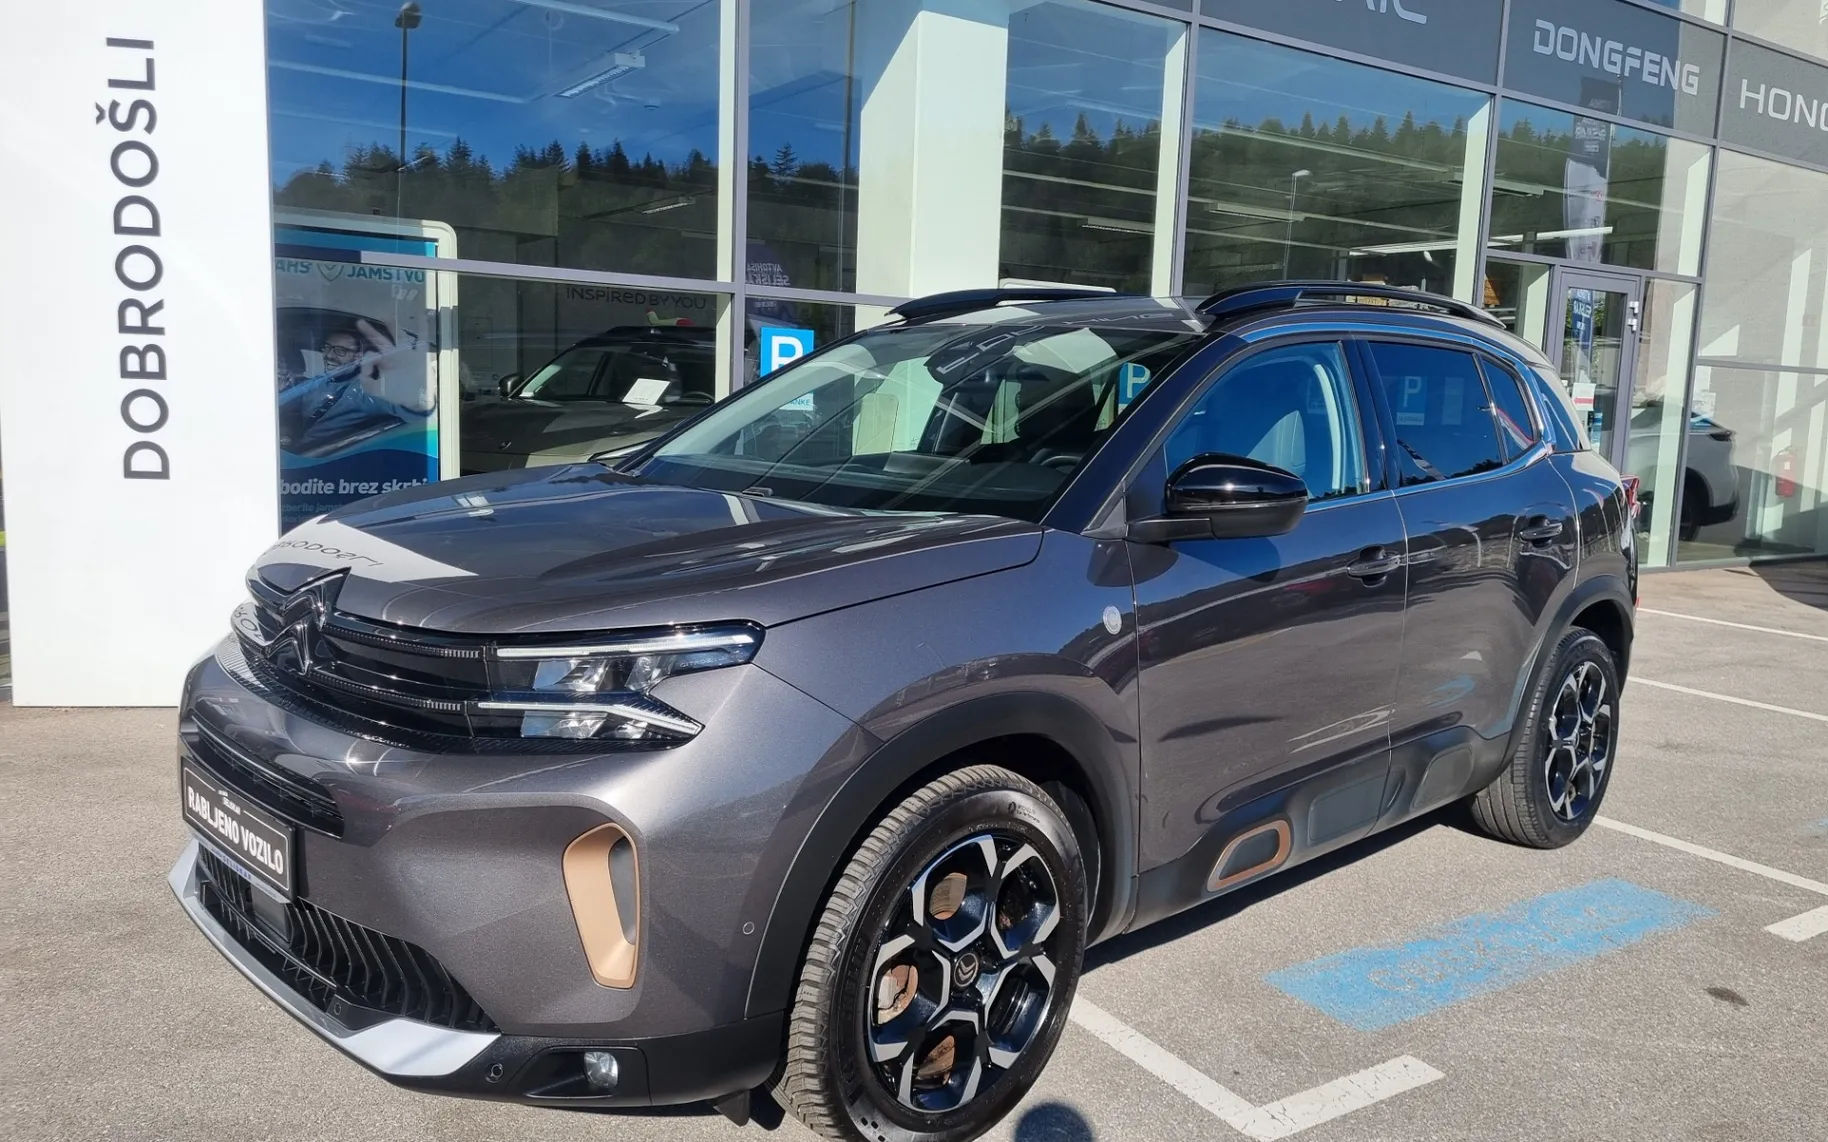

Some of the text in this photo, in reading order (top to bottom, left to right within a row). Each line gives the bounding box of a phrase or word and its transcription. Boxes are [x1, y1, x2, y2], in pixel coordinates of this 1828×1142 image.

[1533, 18, 1700, 96] DONGFENG
[95, 37, 170, 480] DOBRODOŠLI
[649, 293, 669, 306] BY
[673, 295, 707, 310] YOU
[338, 479, 378, 495] brez
[187, 785, 284, 876] RABLJENO VOZILO
